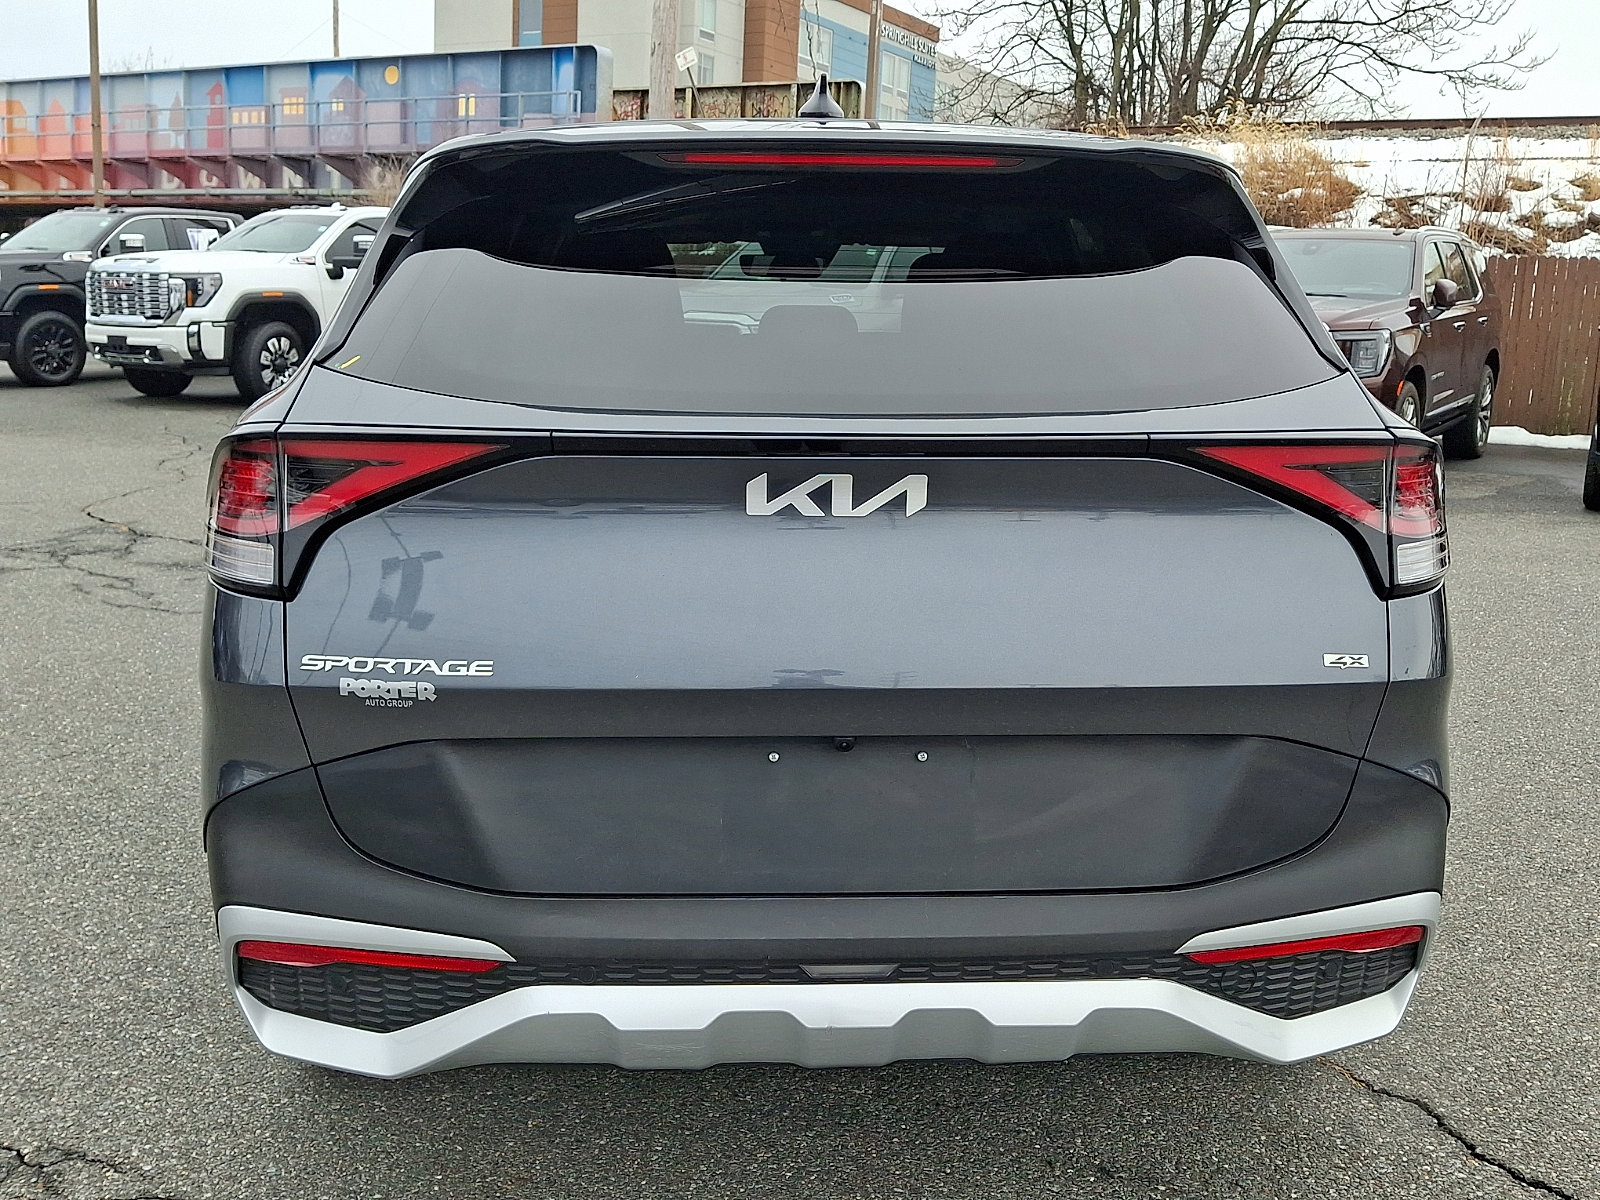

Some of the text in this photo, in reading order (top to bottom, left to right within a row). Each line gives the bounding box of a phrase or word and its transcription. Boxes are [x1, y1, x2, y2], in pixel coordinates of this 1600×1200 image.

[881, 24, 917, 51] SPRINGHILL
[746, 472, 928, 517] KIA
[300, 654, 494, 676] SPORTAGE
[339, 677, 437, 702] PORTER
[365, 698, 413, 708] AUTO GROUP
